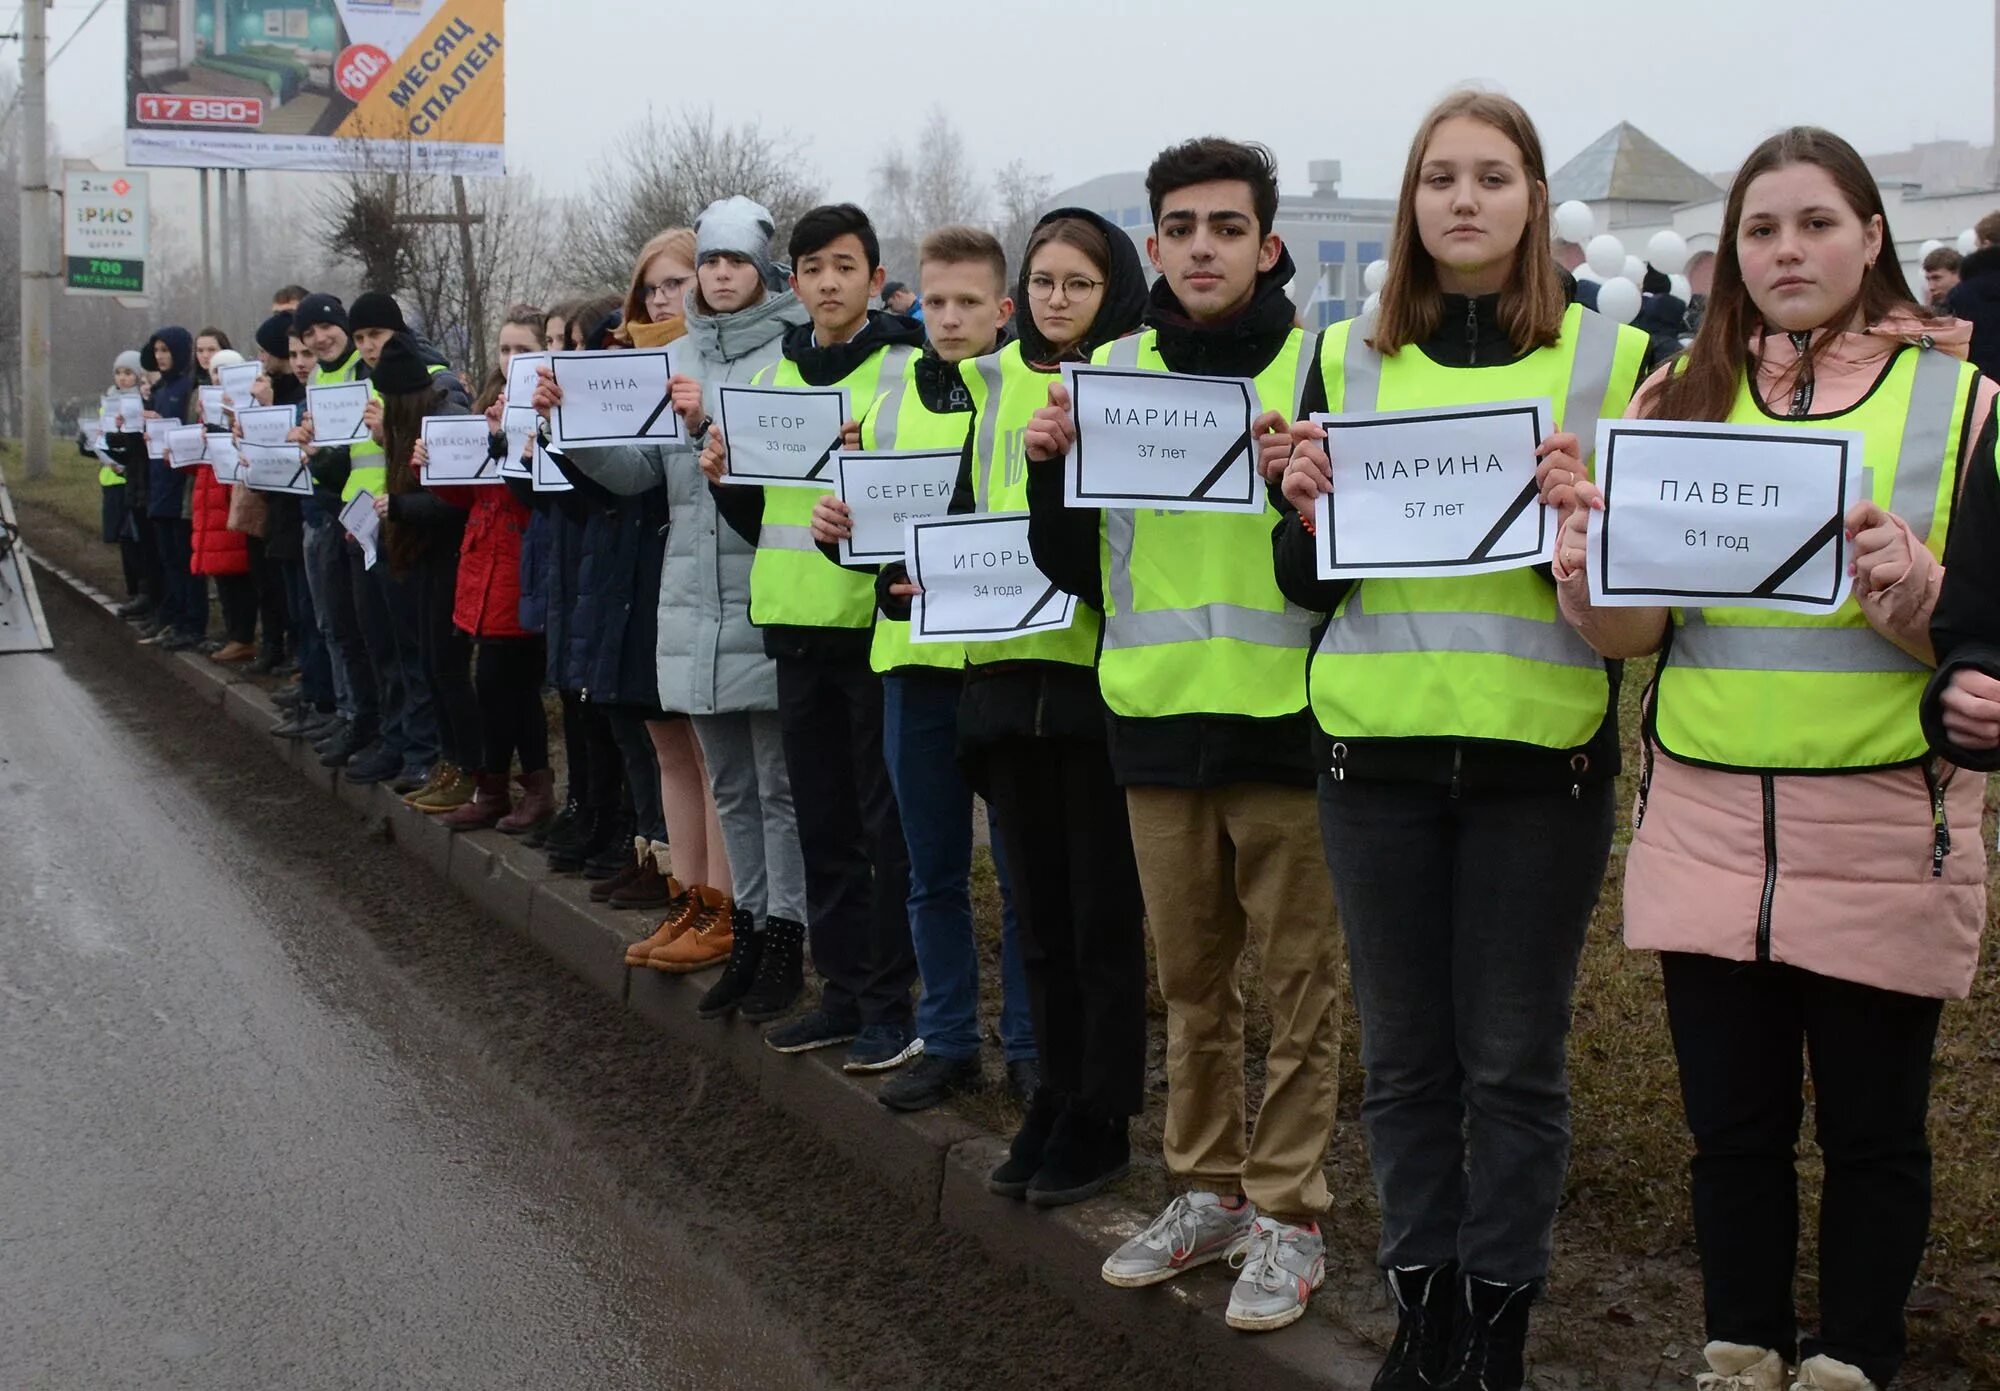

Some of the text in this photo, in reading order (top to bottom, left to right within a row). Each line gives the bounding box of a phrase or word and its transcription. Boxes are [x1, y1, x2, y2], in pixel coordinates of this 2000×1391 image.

[388, 16, 475, 108] МЕСЯЦ
[409, 32, 502, 136] СПАЛЕН
[144, 99, 182, 118] 17
[90, 259, 122, 275] 700
[587, 378, 639, 390] НИНА
[601, 402, 634, 412] 31 год
[758, 415, 806, 429] ЕГОР
[1104, 407, 1218, 428] МАРИНА
[428, 436, 488, 446] АЛЕКСАНД
[766, 440, 807, 453] 33 года
[1137, 444, 1187, 459] 37 лет
[1364, 453, 1504, 481] МАРИНА
[866, 480, 950, 499] СЕРГЕЙ
[1659, 479, 1780, 507] ПАВЕЛ
[1404, 502, 1465, 519] 57 лет
[1684, 528, 1750, 553] 61 год
[953, 549, 1030, 570] ИГОРЬ
[973, 584, 1023, 598] 34 года
